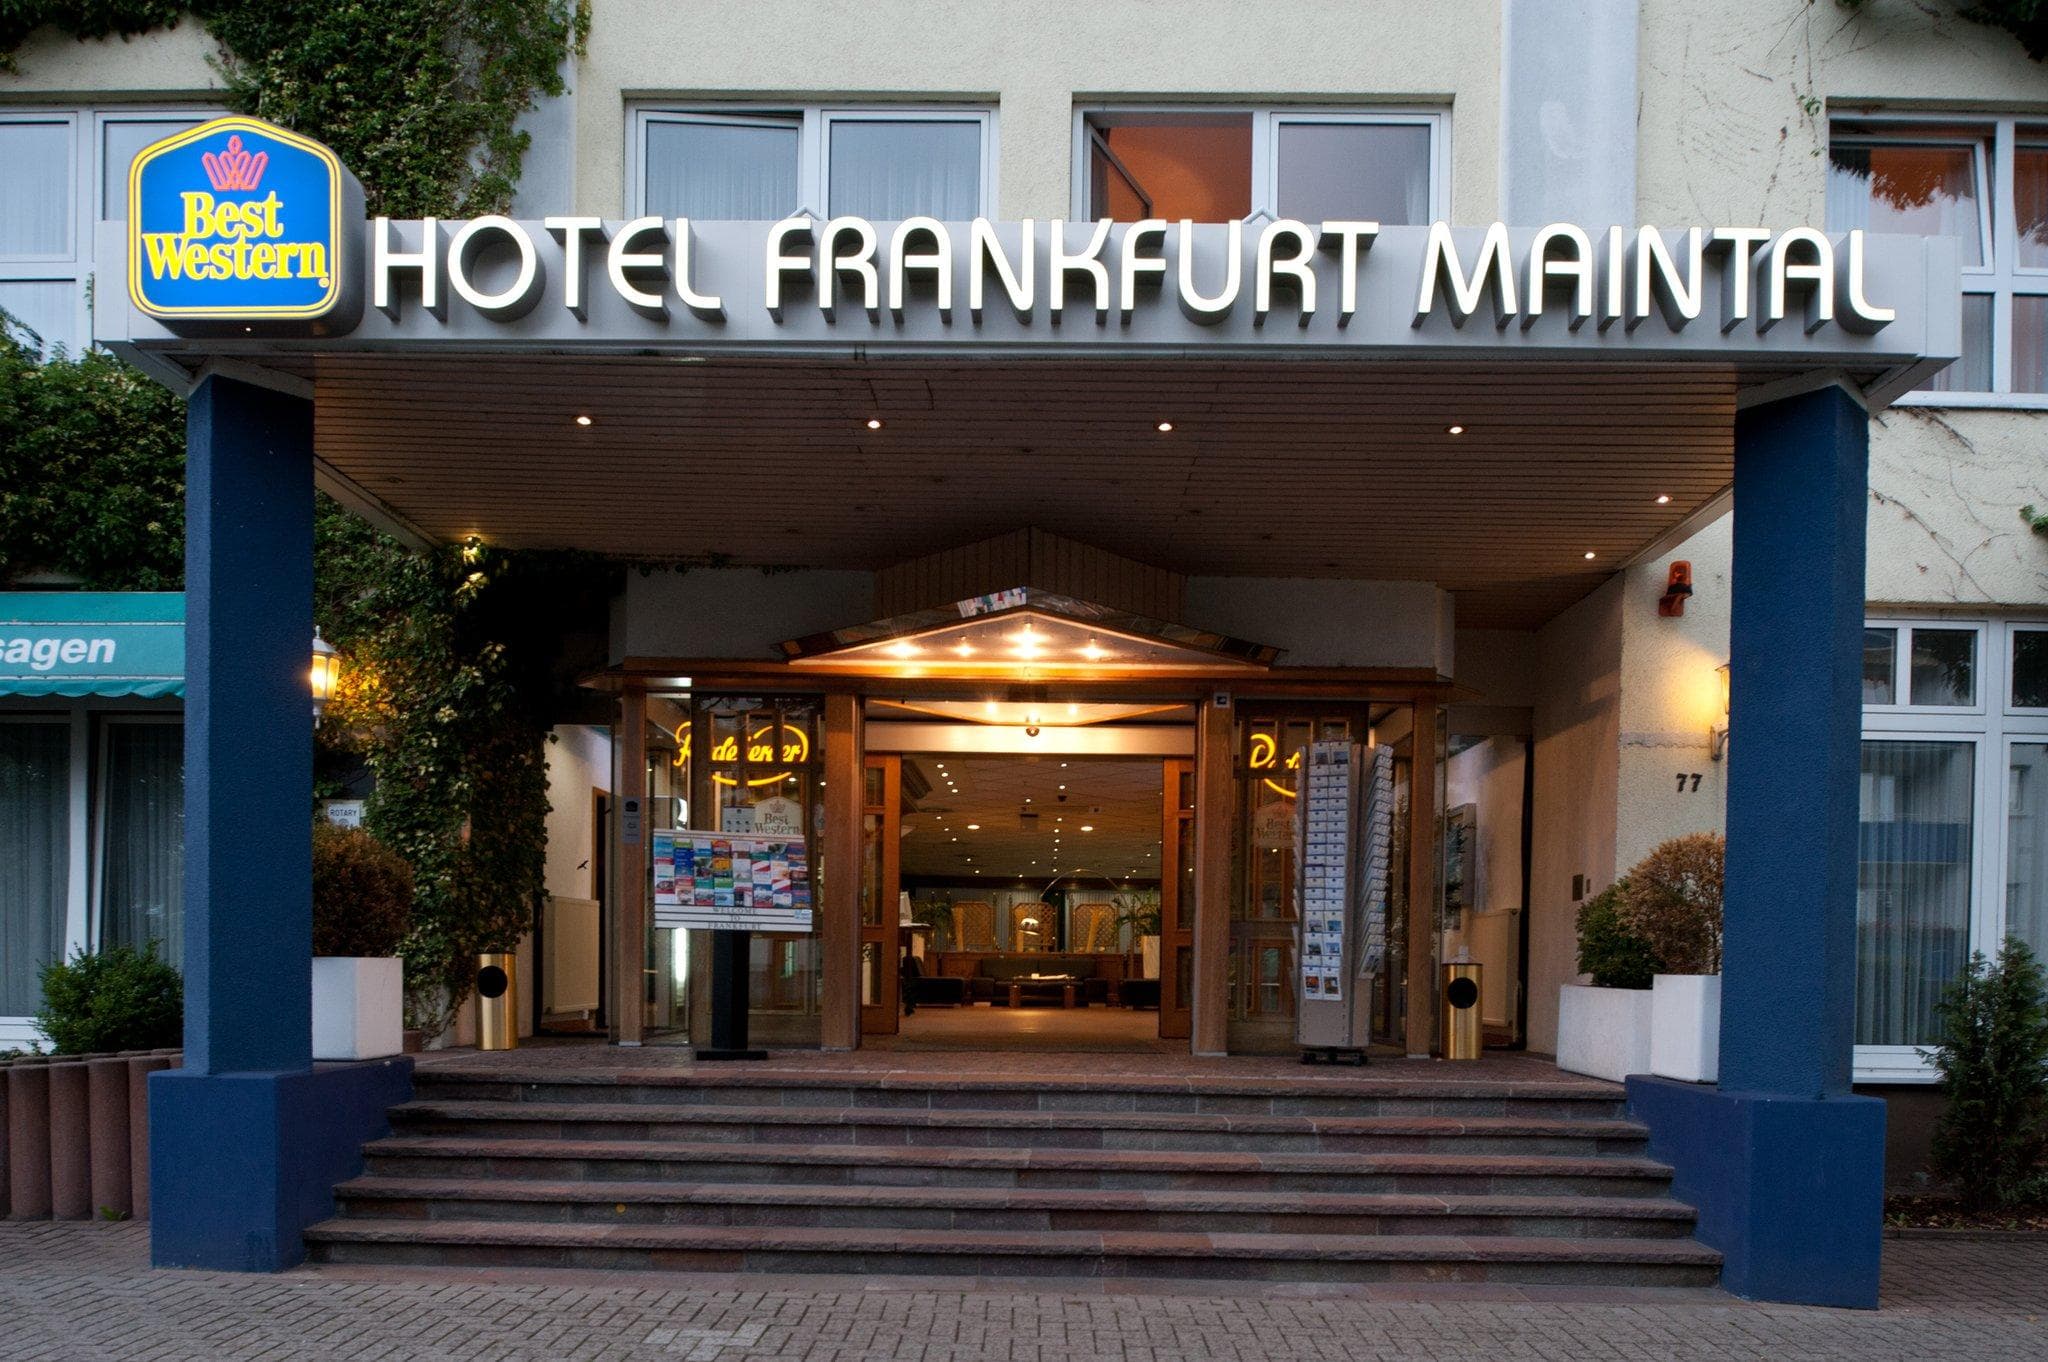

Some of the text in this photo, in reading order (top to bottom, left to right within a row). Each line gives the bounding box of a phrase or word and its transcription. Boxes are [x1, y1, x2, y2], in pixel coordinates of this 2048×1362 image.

[180, 190, 284, 239] Best
[141, 233, 329, 280] Western
[373, 214, 1896, 322] HOTEL FRANKFURT MAINTAL
[0, 637, 117, 671] agen
[1676, 772, 1703, 793] 77
[329, 808, 358, 817] ROTARY
[764, 812, 789, 825] Best
[754, 822, 800, 835] Western
[712, 906, 757, 915] WELCOME
[707, 922, 762, 930] FRANKFURT
